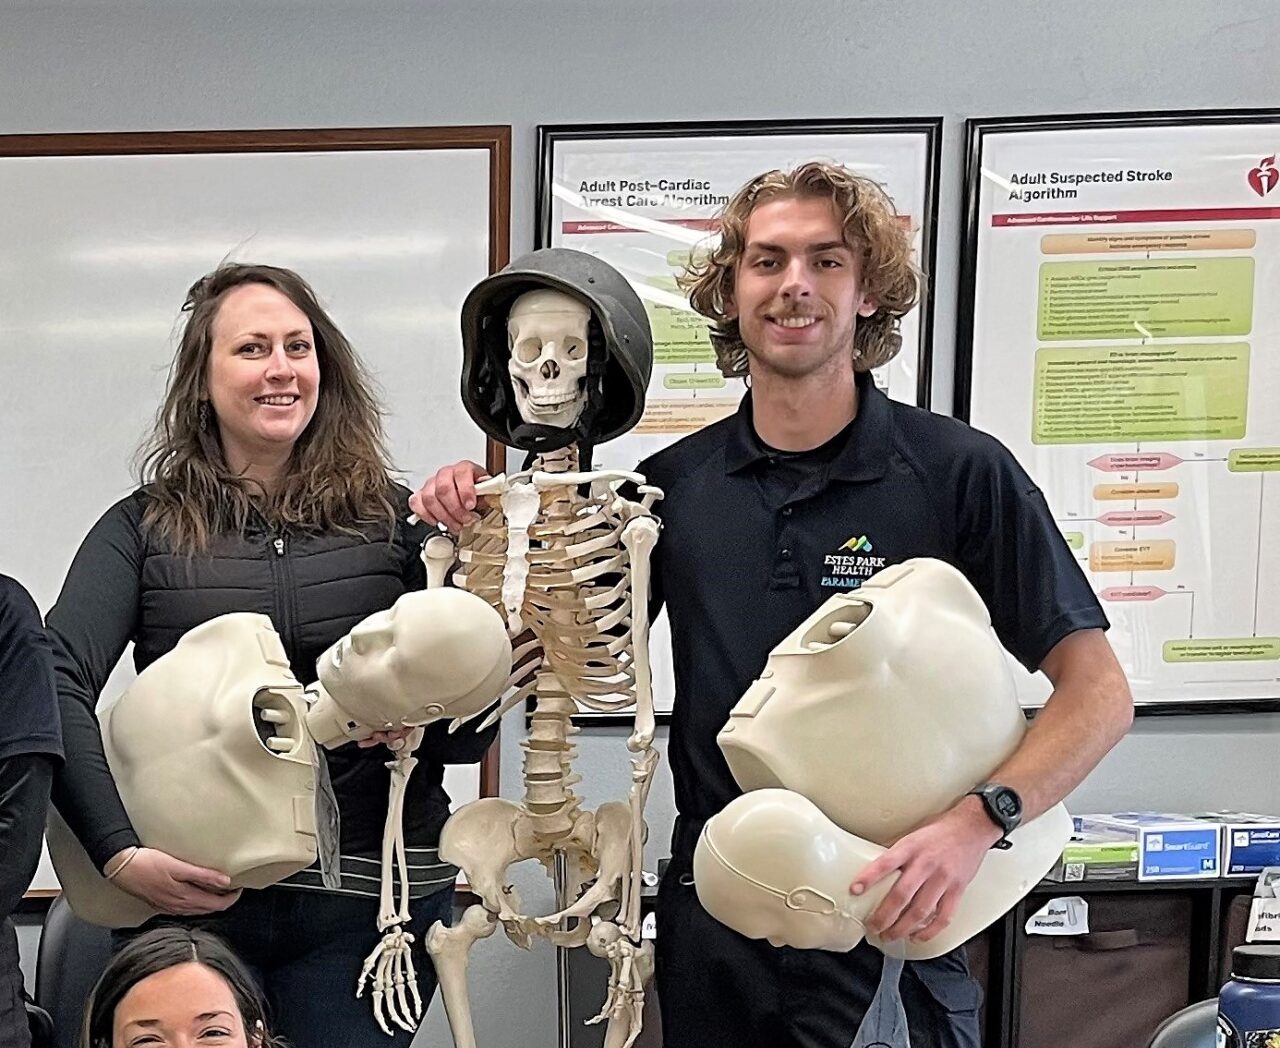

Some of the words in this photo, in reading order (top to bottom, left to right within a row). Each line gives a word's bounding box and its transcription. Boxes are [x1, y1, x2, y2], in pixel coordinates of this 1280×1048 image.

[1010, 174, 1046, 185] Adult
[1050, 171, 1123, 184] Suspected
[1127, 170, 1173, 182] Stroke
[580, 181, 616, 192] Adult
[620, 179, 711, 191] Post-Cardiac
[626, 195, 658, 207] Care
[1009, 188, 1078, 202] Algorithm
[824, 555, 855, 566] ESTES
[856, 556, 886, 567] PARK
[832, 565, 873, 576] HEALTH
[1203, 859, 1214, 870] M
[1034, 920, 1064, 928] Needle
